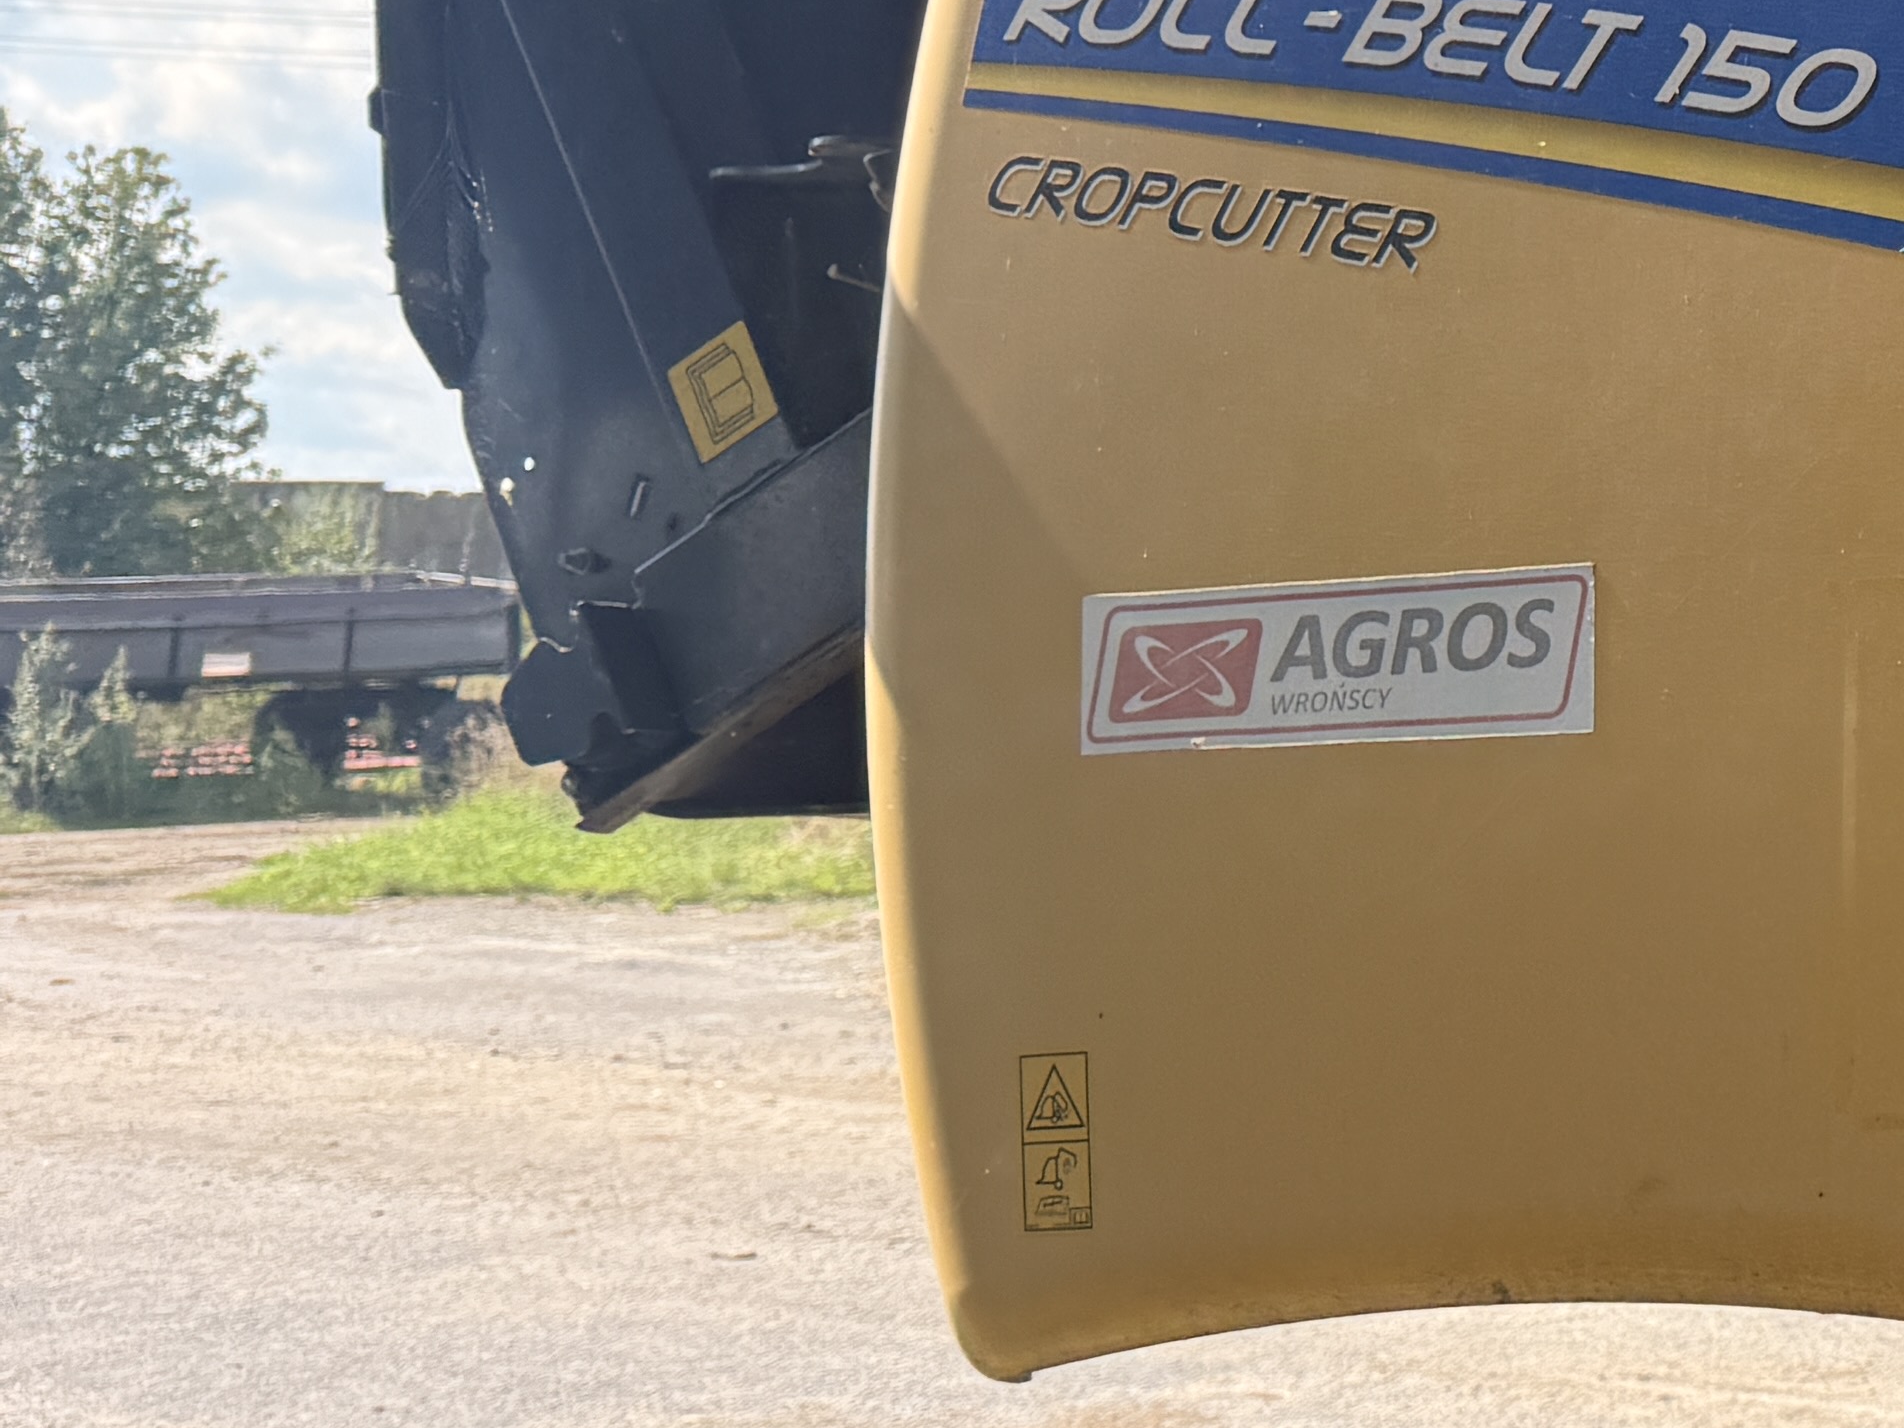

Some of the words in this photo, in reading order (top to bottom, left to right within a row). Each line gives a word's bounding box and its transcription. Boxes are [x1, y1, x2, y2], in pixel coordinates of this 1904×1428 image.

[1654, 21, 1879, 130] 150
[986, 155, 1438, 274] CROPCUTTER
[1269, 597, 1556, 684] AGROS
[1270, 682, 1395, 716] WROŃSCY
